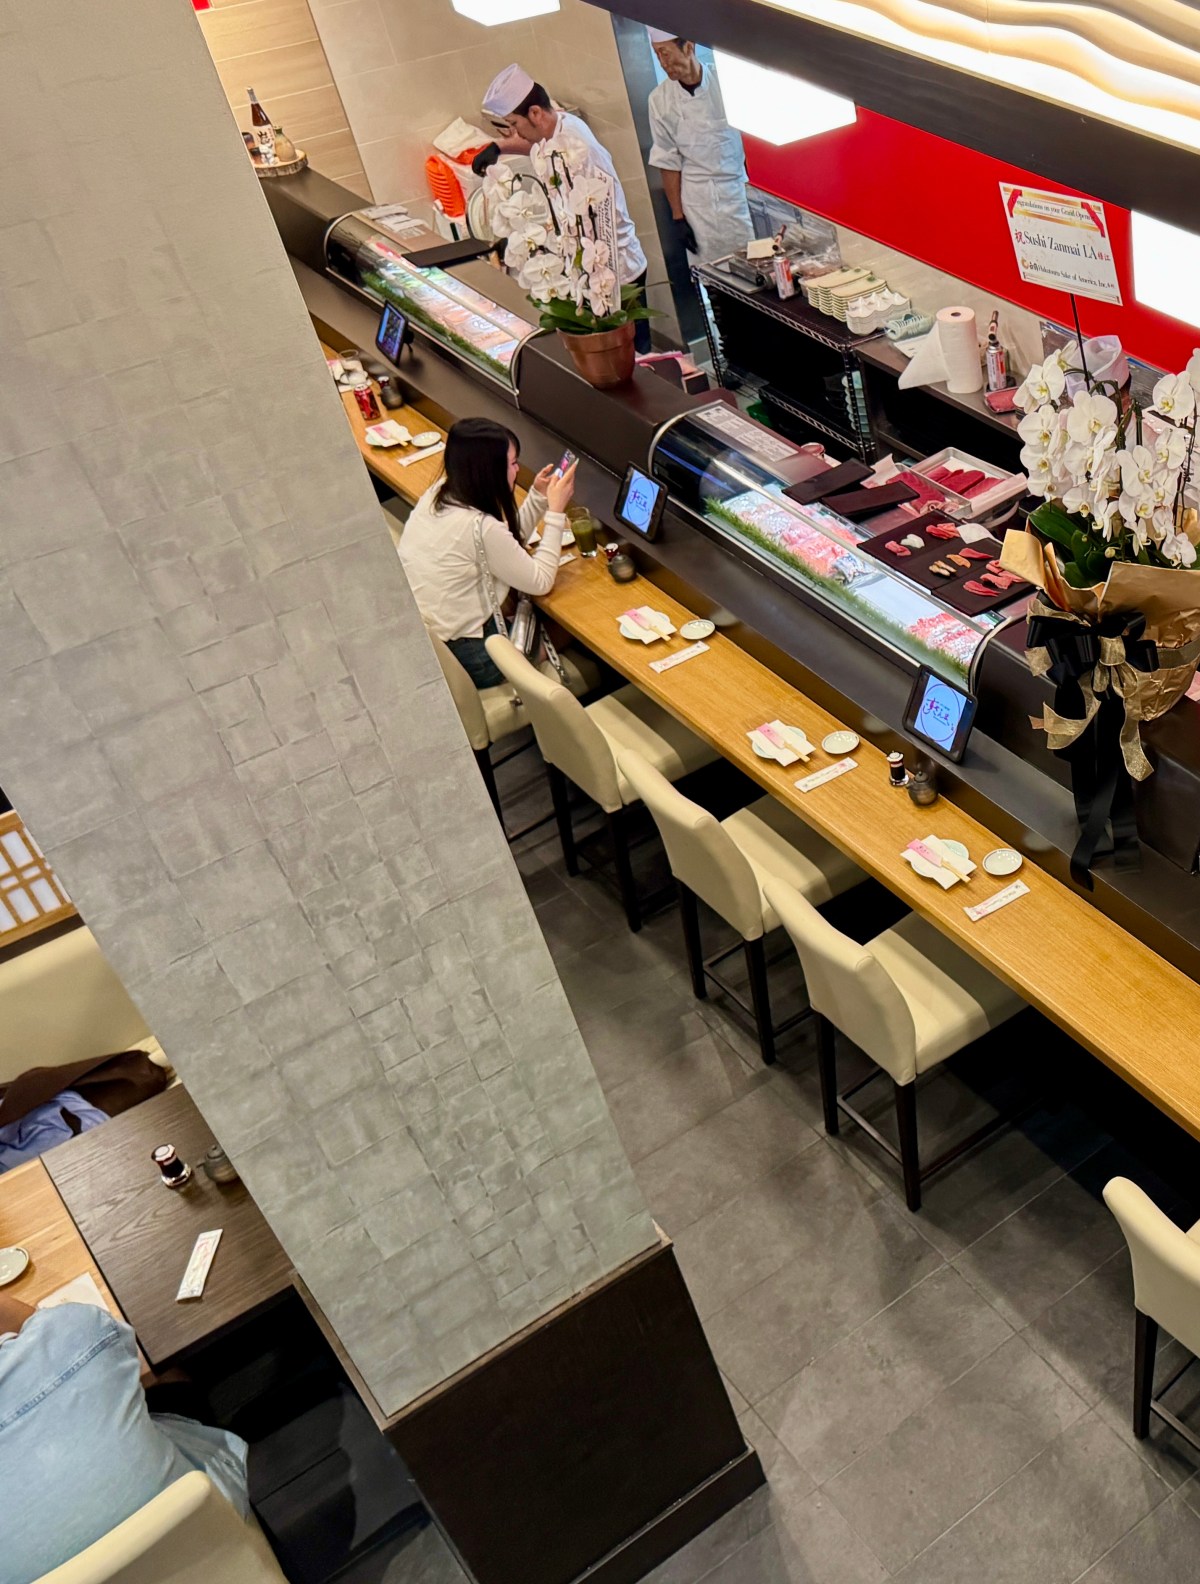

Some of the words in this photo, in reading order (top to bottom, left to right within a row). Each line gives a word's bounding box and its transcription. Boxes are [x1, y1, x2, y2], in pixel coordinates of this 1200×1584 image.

[1024, 230, 1047, 249] Sushi
[1047, 236, 1081, 257] Zanmai
[1083, 244, 1098, 260] LA
